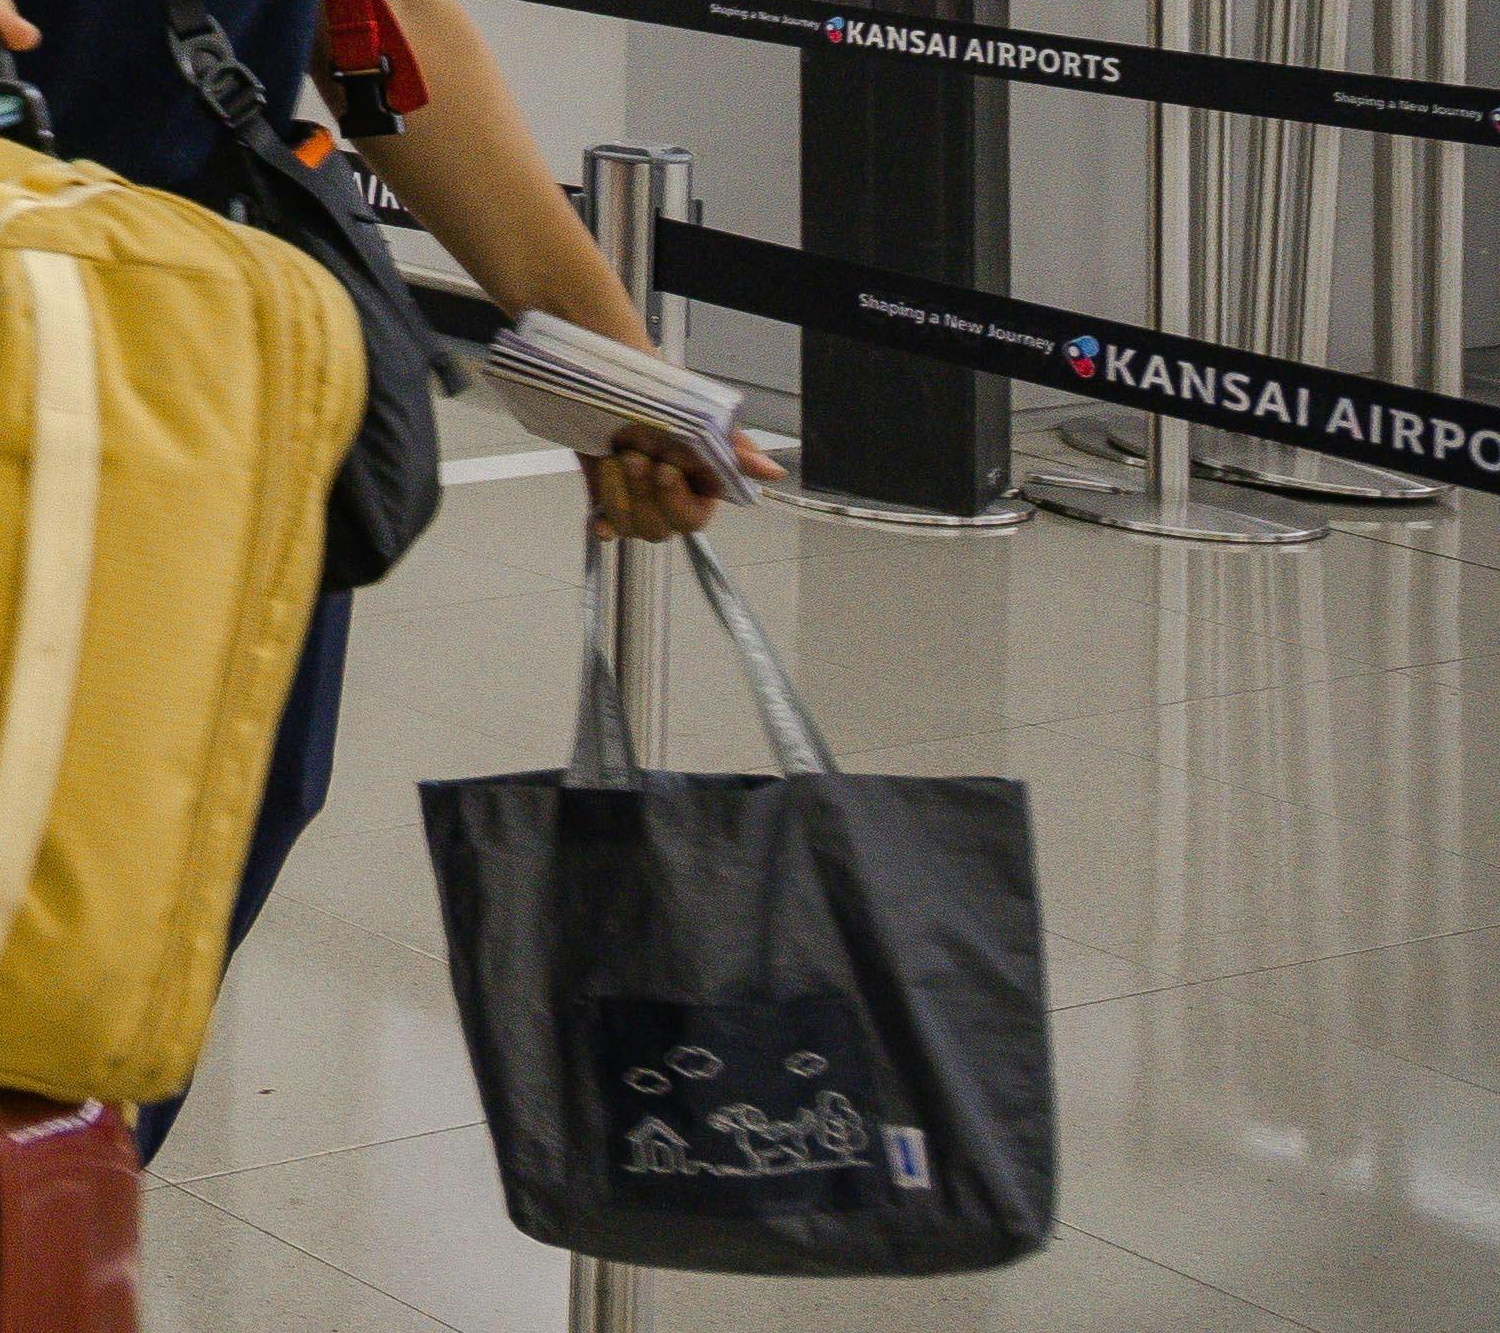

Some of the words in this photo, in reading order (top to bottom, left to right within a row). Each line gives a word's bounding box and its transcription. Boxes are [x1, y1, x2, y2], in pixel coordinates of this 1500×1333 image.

[847, 20, 956, 60] KANSAI
[963, 38, 1122, 82] AIRPORTS
[1333, 91, 1385, 110] Shaping
[1399, 100, 1429, 113] New
[1432, 104, 1484, 122] Journey
[858, 293, 926, 324] Shaping
[928, 312, 940, 325] a
[943, 313, 983, 334] New
[987, 323, 1055, 355] Journey
[1106, 344, 1311, 428] KANSAI
[1326, 396, 1500, 473] AIRPO
